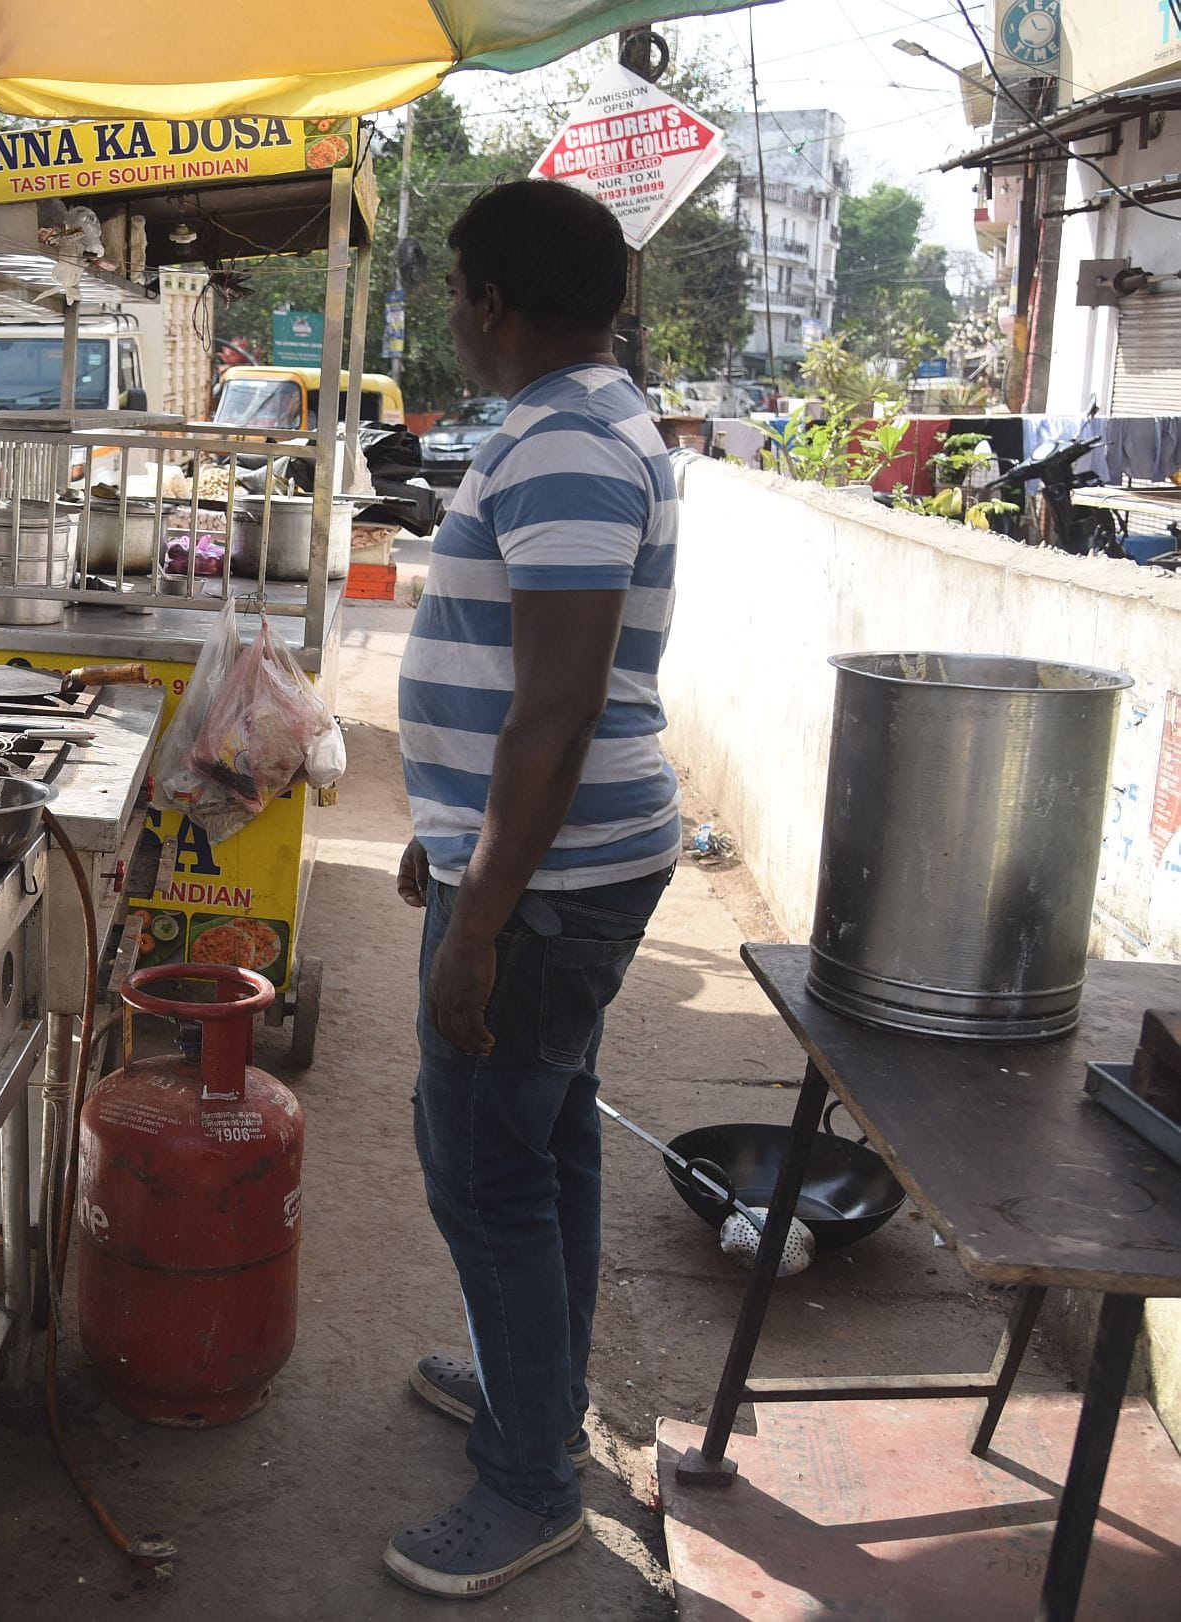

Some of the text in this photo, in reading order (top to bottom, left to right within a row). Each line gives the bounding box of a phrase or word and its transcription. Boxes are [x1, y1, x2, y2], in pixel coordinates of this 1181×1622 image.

[1018, 0, 1058, 16] TEA
[1012, 42, 1059, 61] TIME
[587, 86, 648, 106] ADMISSION
[603, 100, 634, 114] OPEN
[564, 107, 681, 149] CHILDREN'S
[94, 121, 157, 162] KA
[167, 117, 292, 155] DOSA
[553, 125, 699, 175] ACADEMY COLLEGE
[10, 157, 249, 193] TASTE OF SOUTH INDIAN
[589, 157, 660, 178] CBSE BOARD
[597, 170, 661, 189] NUR. TO XII
[629, 181, 665, 196] 99999
[615, 199, 634, 208] MALL
[636, 193, 664, 204] AVENUE
[162, 881, 251, 908] NDIAN
[218, 1127, 250, 1142] 1906
